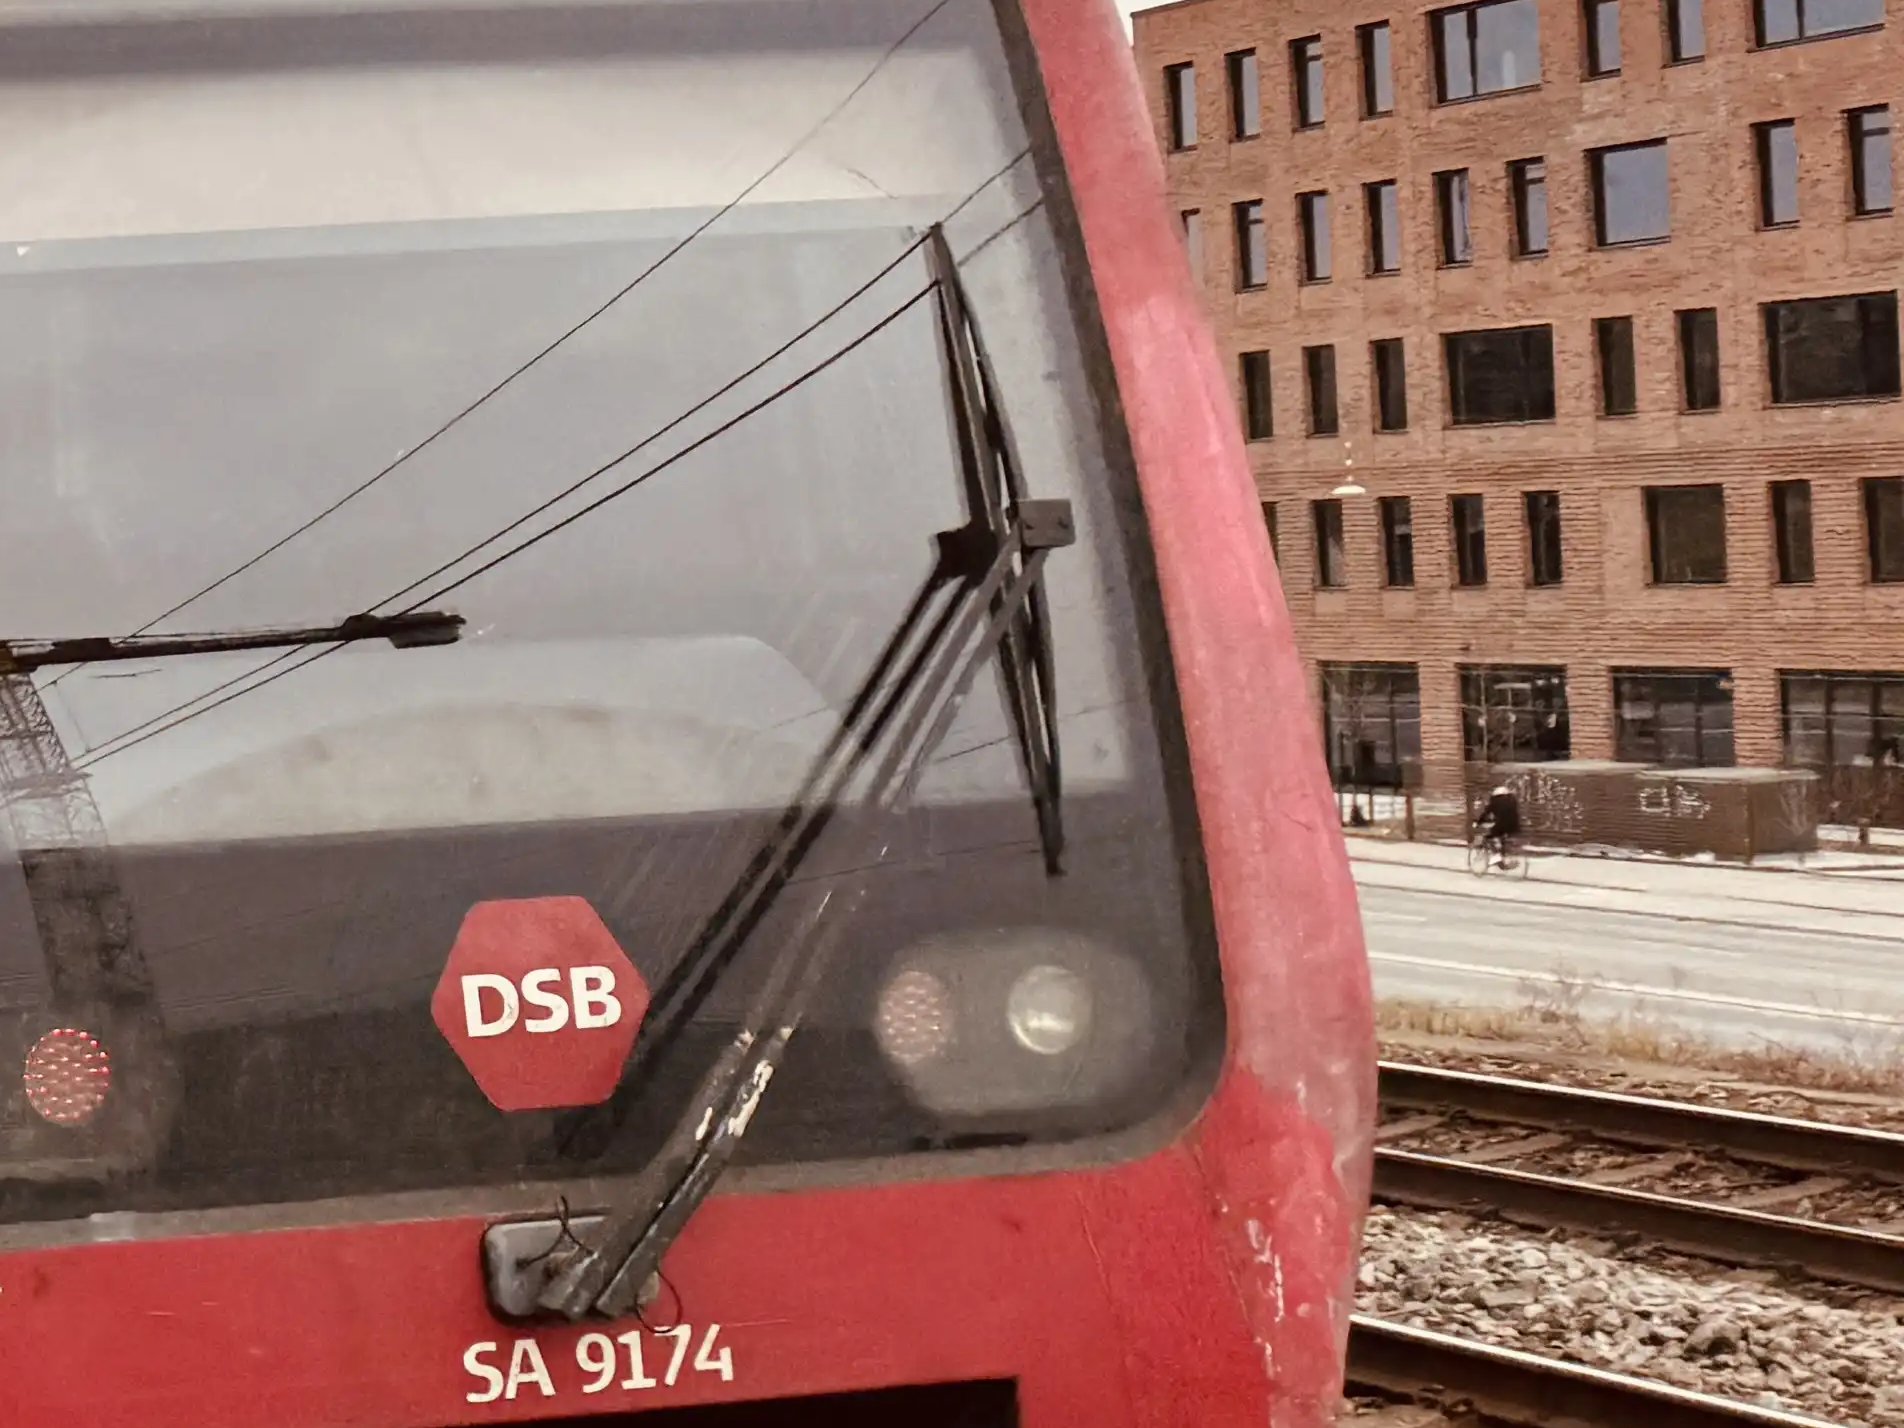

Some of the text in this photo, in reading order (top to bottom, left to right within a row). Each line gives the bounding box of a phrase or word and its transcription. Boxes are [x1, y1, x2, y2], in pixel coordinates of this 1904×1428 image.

[460, 965, 623, 1038] DSB
[462, 1323, 735, 1404] SA 9174
